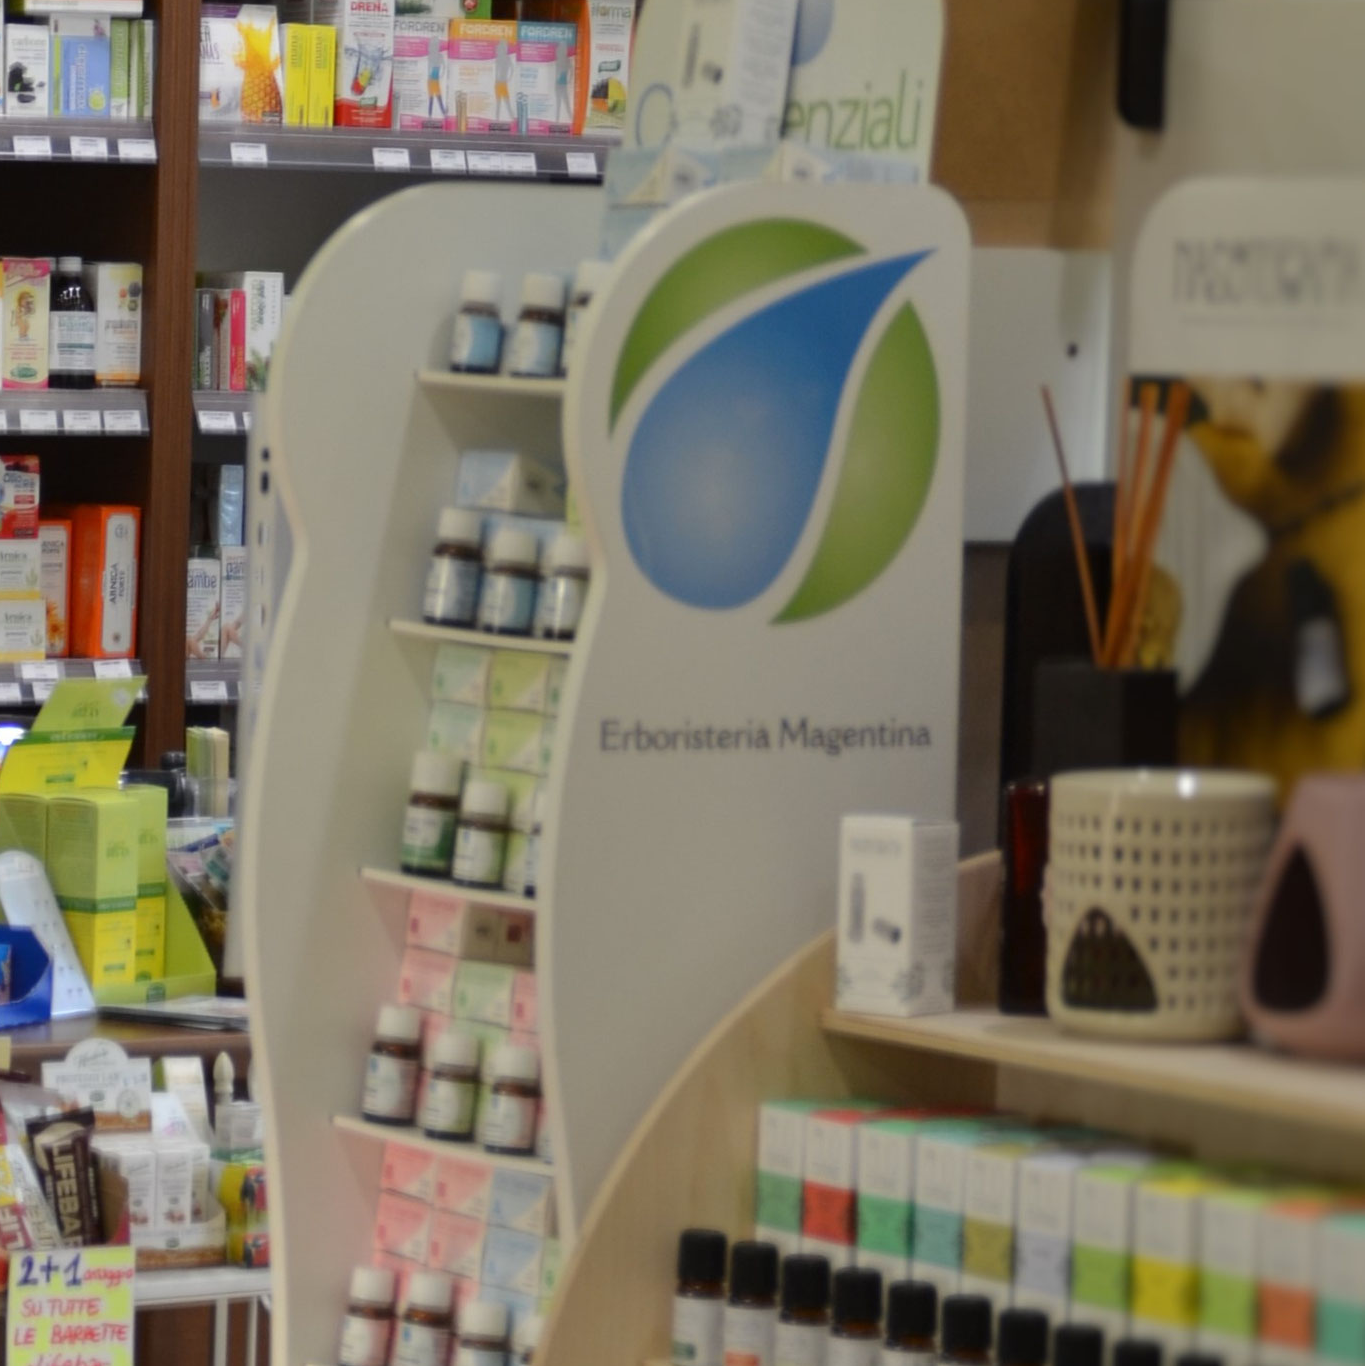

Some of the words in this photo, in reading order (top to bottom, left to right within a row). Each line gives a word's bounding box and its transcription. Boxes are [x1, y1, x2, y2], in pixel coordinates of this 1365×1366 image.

[786, 67, 925, 151] enziali
[599, 718, 771, 753] Erboristeria
[778, 715, 933, 758] Magentina
[16, 1253, 84, 1288] 2+1
[22, 1298, 43, 1317] SU
[48, 1297, 101, 1317] TUTTE
[14, 1325, 36, 1346] LE
